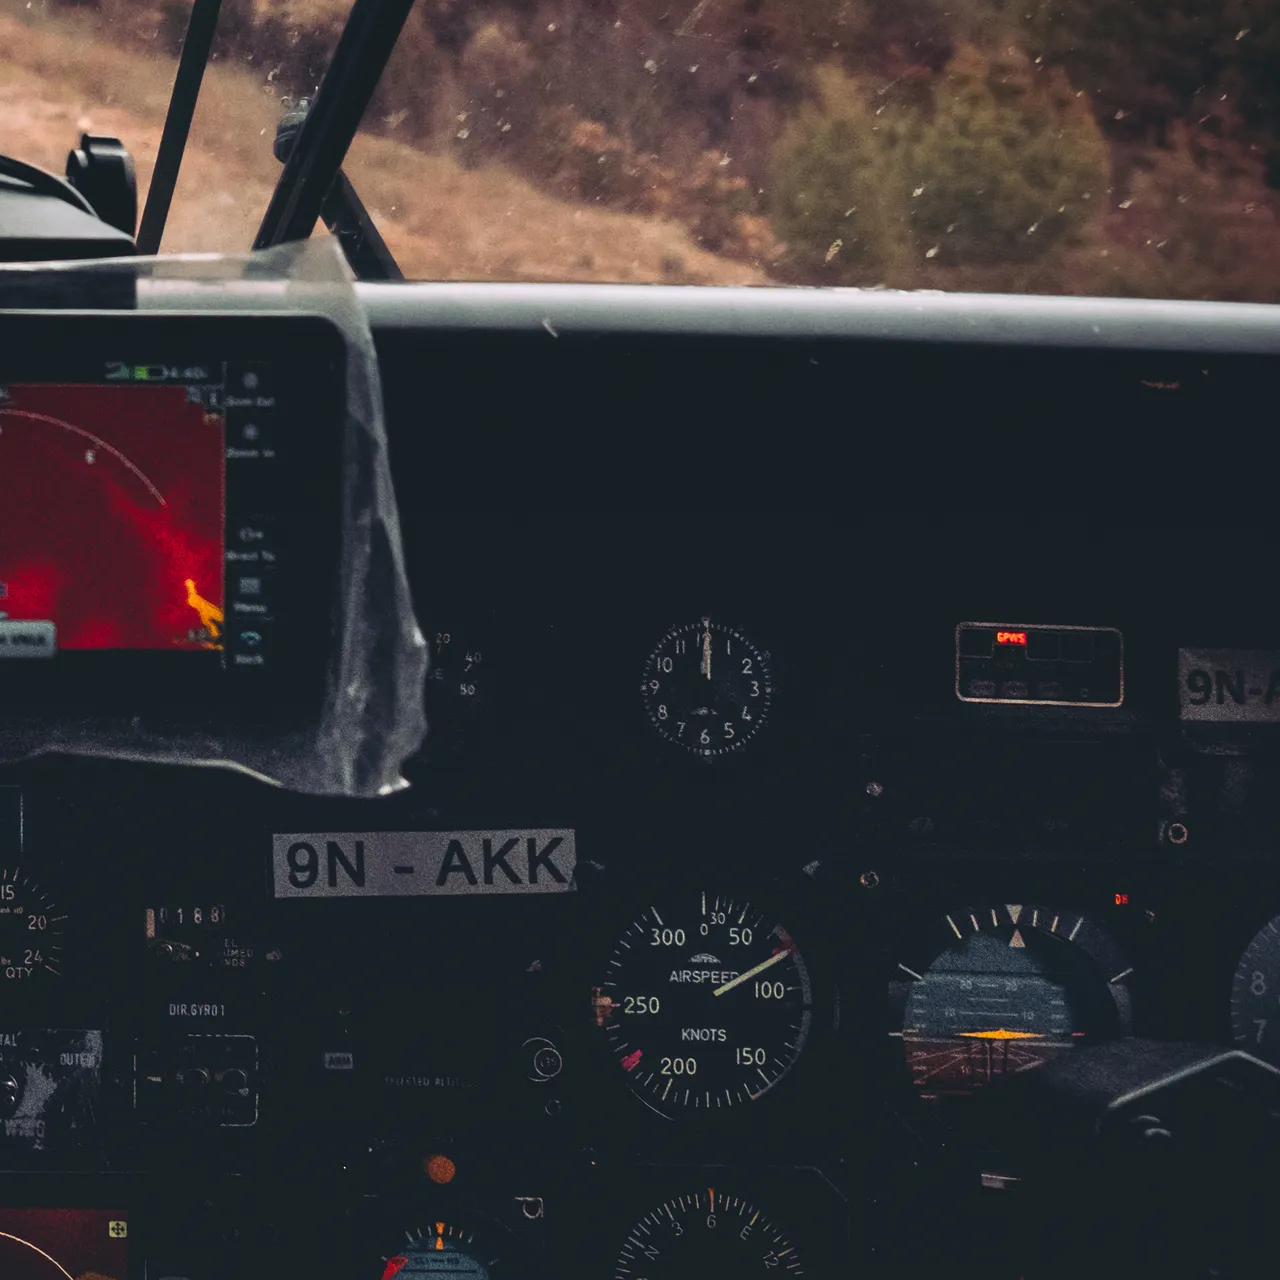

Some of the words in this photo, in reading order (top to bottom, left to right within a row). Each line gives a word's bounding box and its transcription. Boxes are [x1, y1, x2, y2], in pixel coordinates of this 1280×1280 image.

[674, 638, 686, 655] 11
[995, 631, 1027, 646] GPWS
[656, 655, 674, 674] 10
[741, 657, 753, 675] 2
[749, 680, 761, 698] 3
[657, 703, 669, 721] 8
[699, 728, 711, 745] 6
[723, 721, 736, 739] 5
[286, 840, 366, 889] 9N
[435, 836, 568, 888] AKK
[0, 883, 16, 901] 15
[26, 914, 48, 931] 20
[709, 911, 727, 926] 30
[649, 927, 687, 947] 300
[727, 926, 754, 947] 50
[23, 948, 44, 966] 24
[4, 966, 34, 980] QTY
[753, 980, 786, 1001] 100
[622, 995, 662, 1016] 250
[680, 1027, 728, 1043] KNOTS
[734, 1046, 768, 1066] 150
[659, 1056, 698, 1076] 200
[705, 1213, 718, 1230] 6
[761, 1250, 781, 1270] 12
